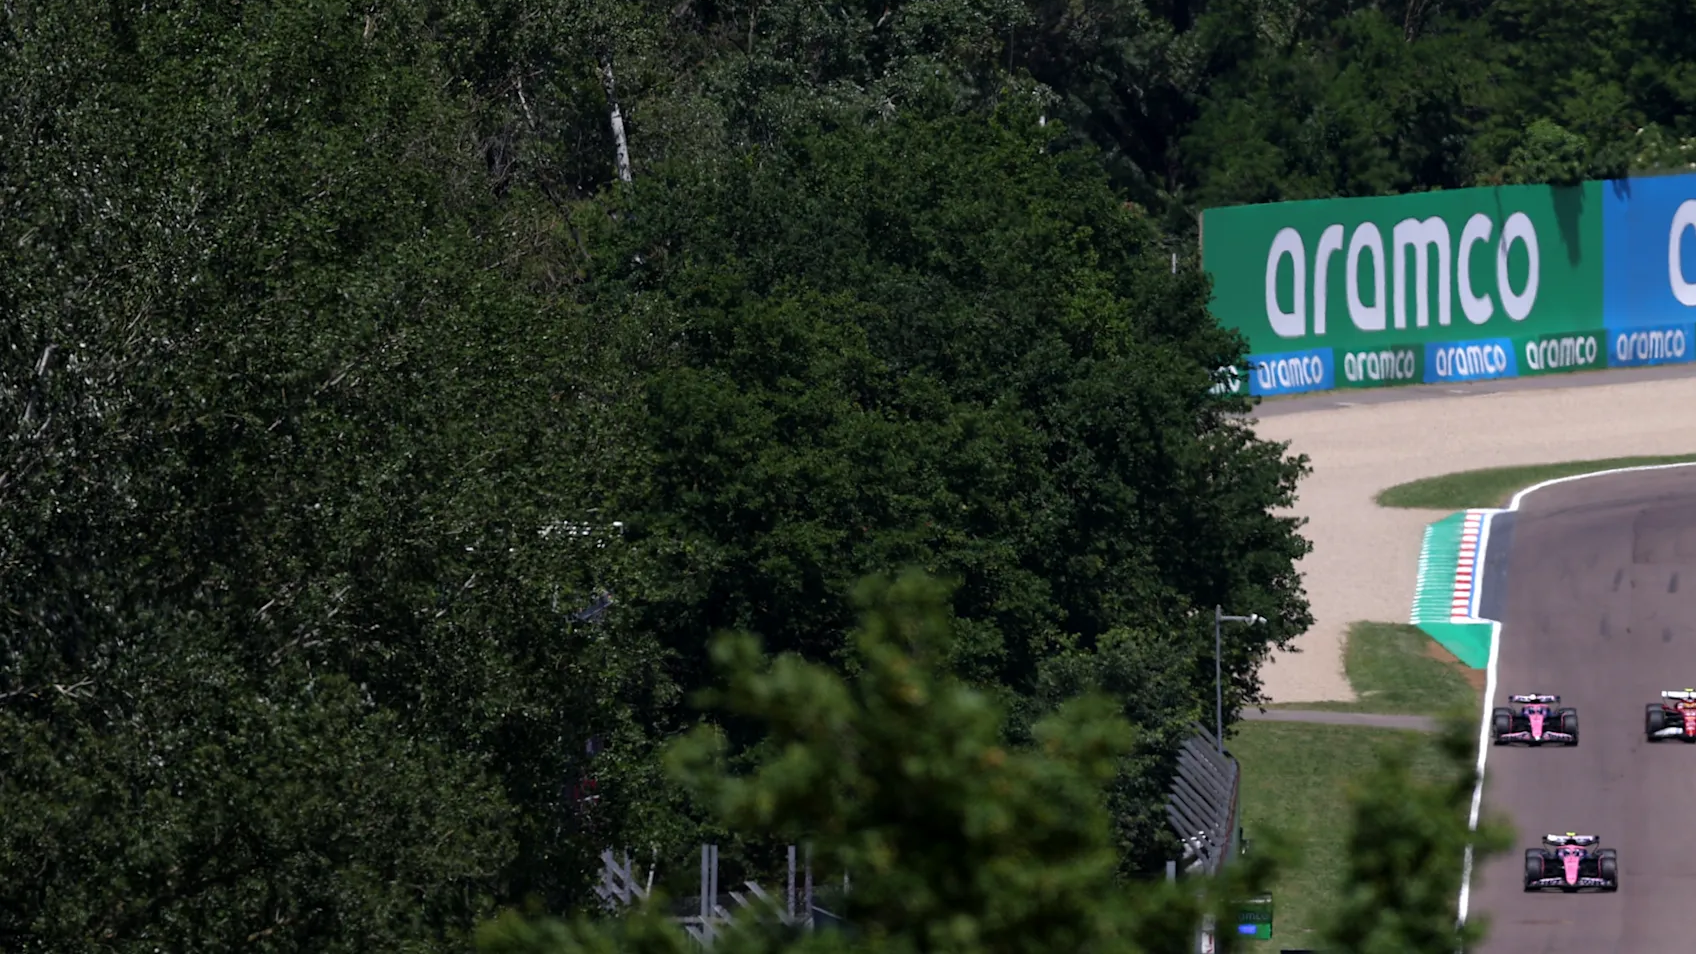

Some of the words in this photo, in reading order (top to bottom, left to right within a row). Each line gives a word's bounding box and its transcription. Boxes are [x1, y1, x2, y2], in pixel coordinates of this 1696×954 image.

[1265, 211, 1540, 337] aramco
[1435, 342, 1507, 377] aramco
[1526, 335, 1597, 370] aramco
[1616, 329, 1686, 361] aramco
[1257, 354, 1323, 390] aramco
[1344, 349, 1415, 382] aramco
